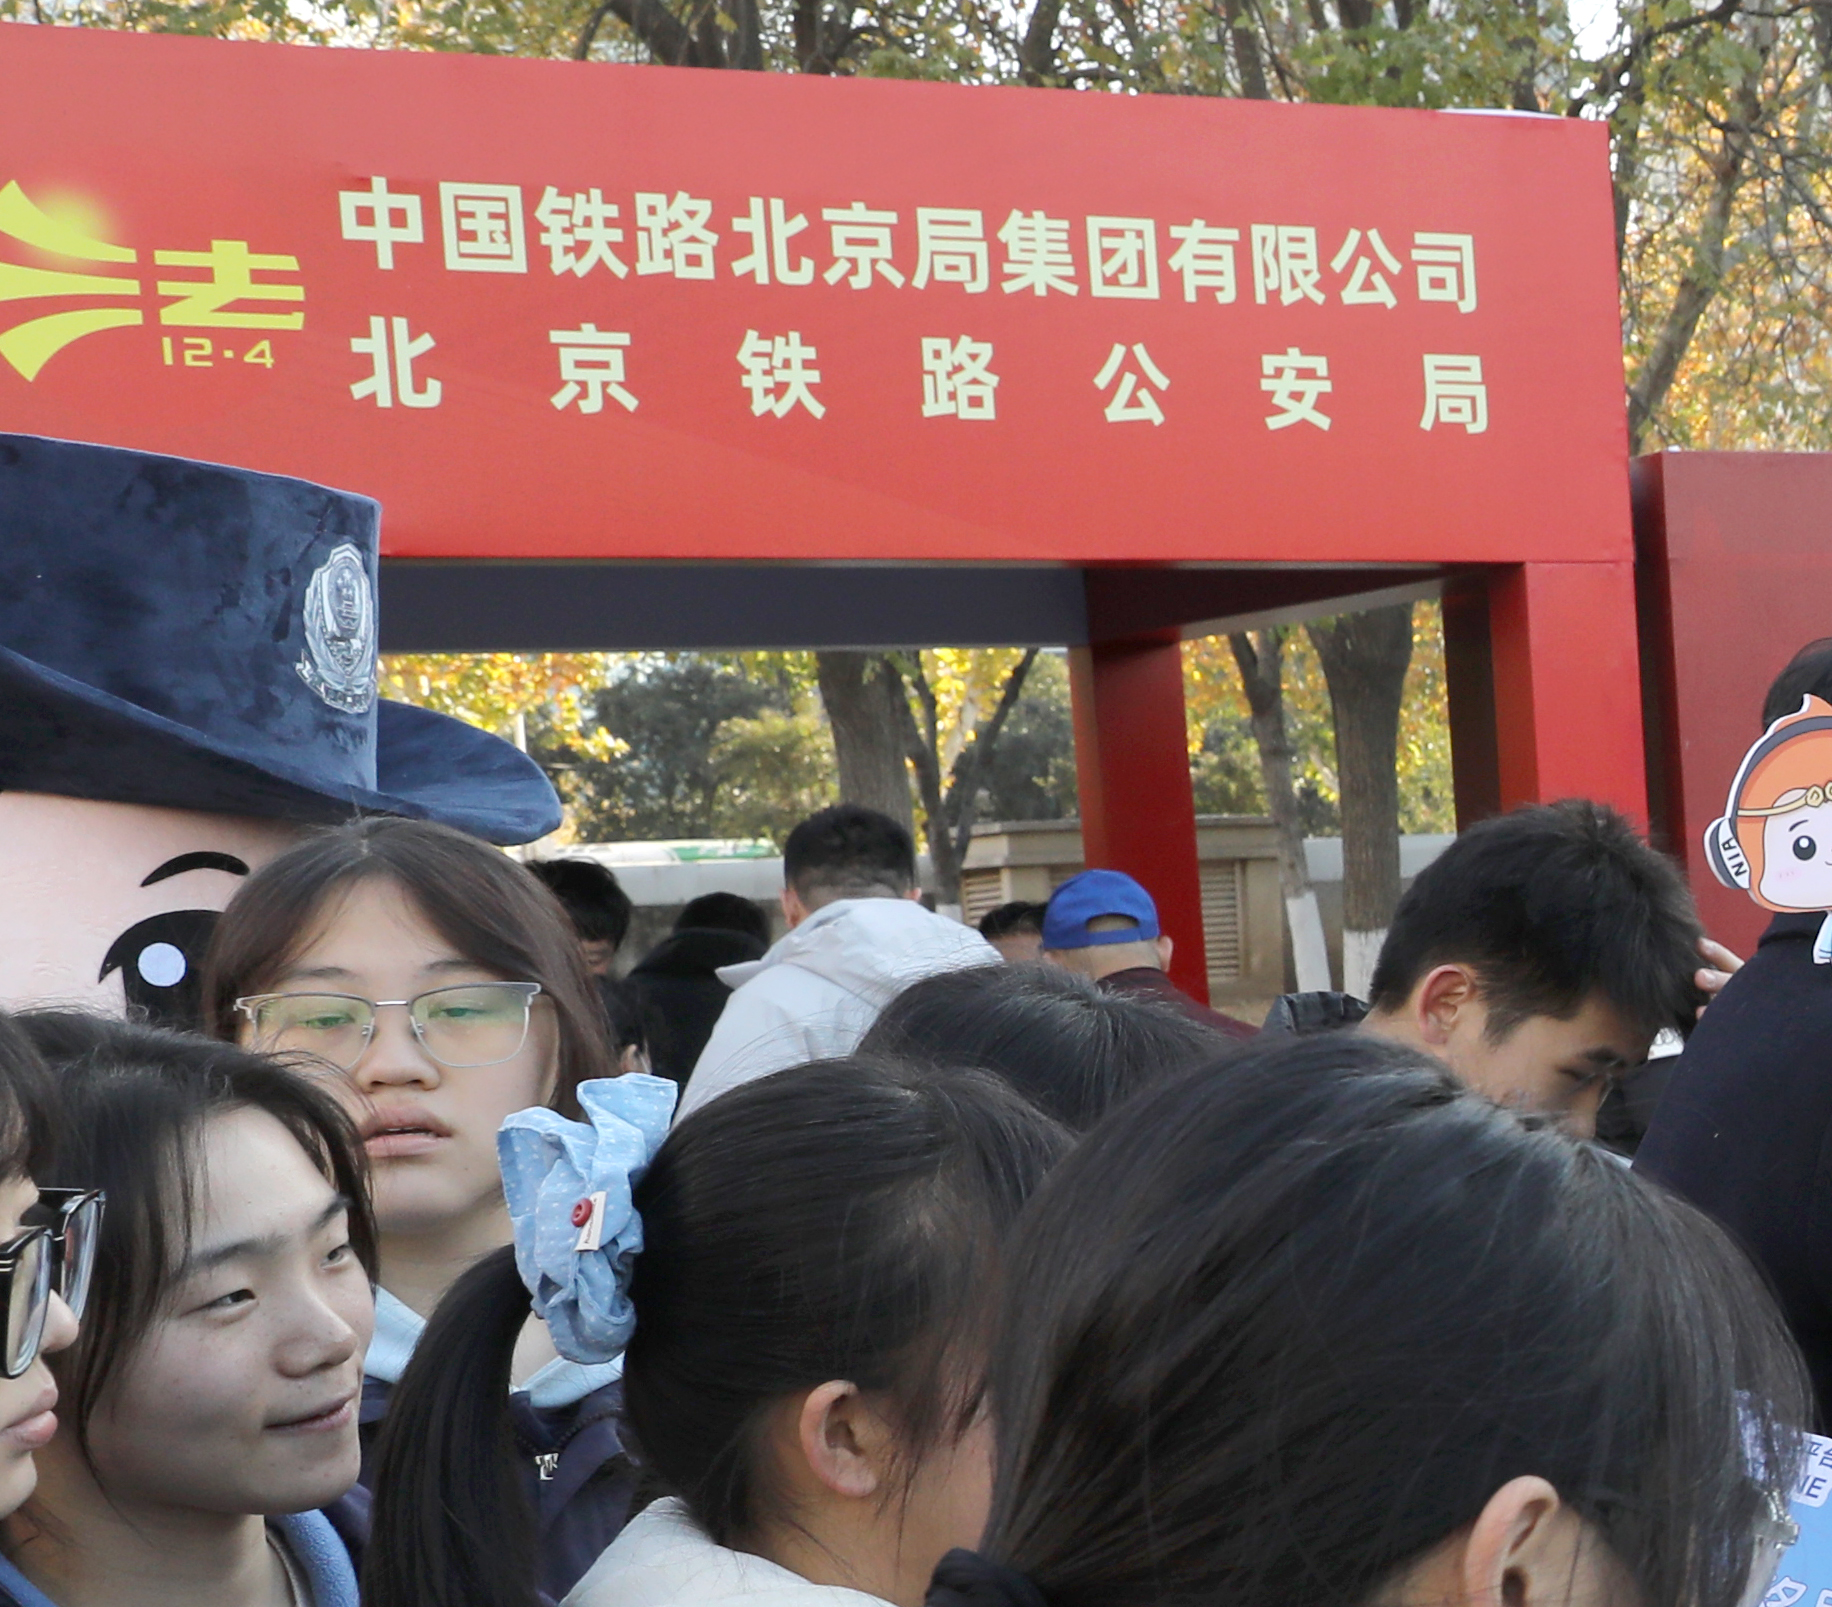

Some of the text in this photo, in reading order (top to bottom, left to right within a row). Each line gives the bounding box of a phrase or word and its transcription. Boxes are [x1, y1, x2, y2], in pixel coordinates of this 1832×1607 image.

[338, 176, 1478, 313] 中国铁路北京局集团有限公司
[350, 316, 1489, 434] 北京铁路公安局
[1722, 836, 1749, 879] NIA
